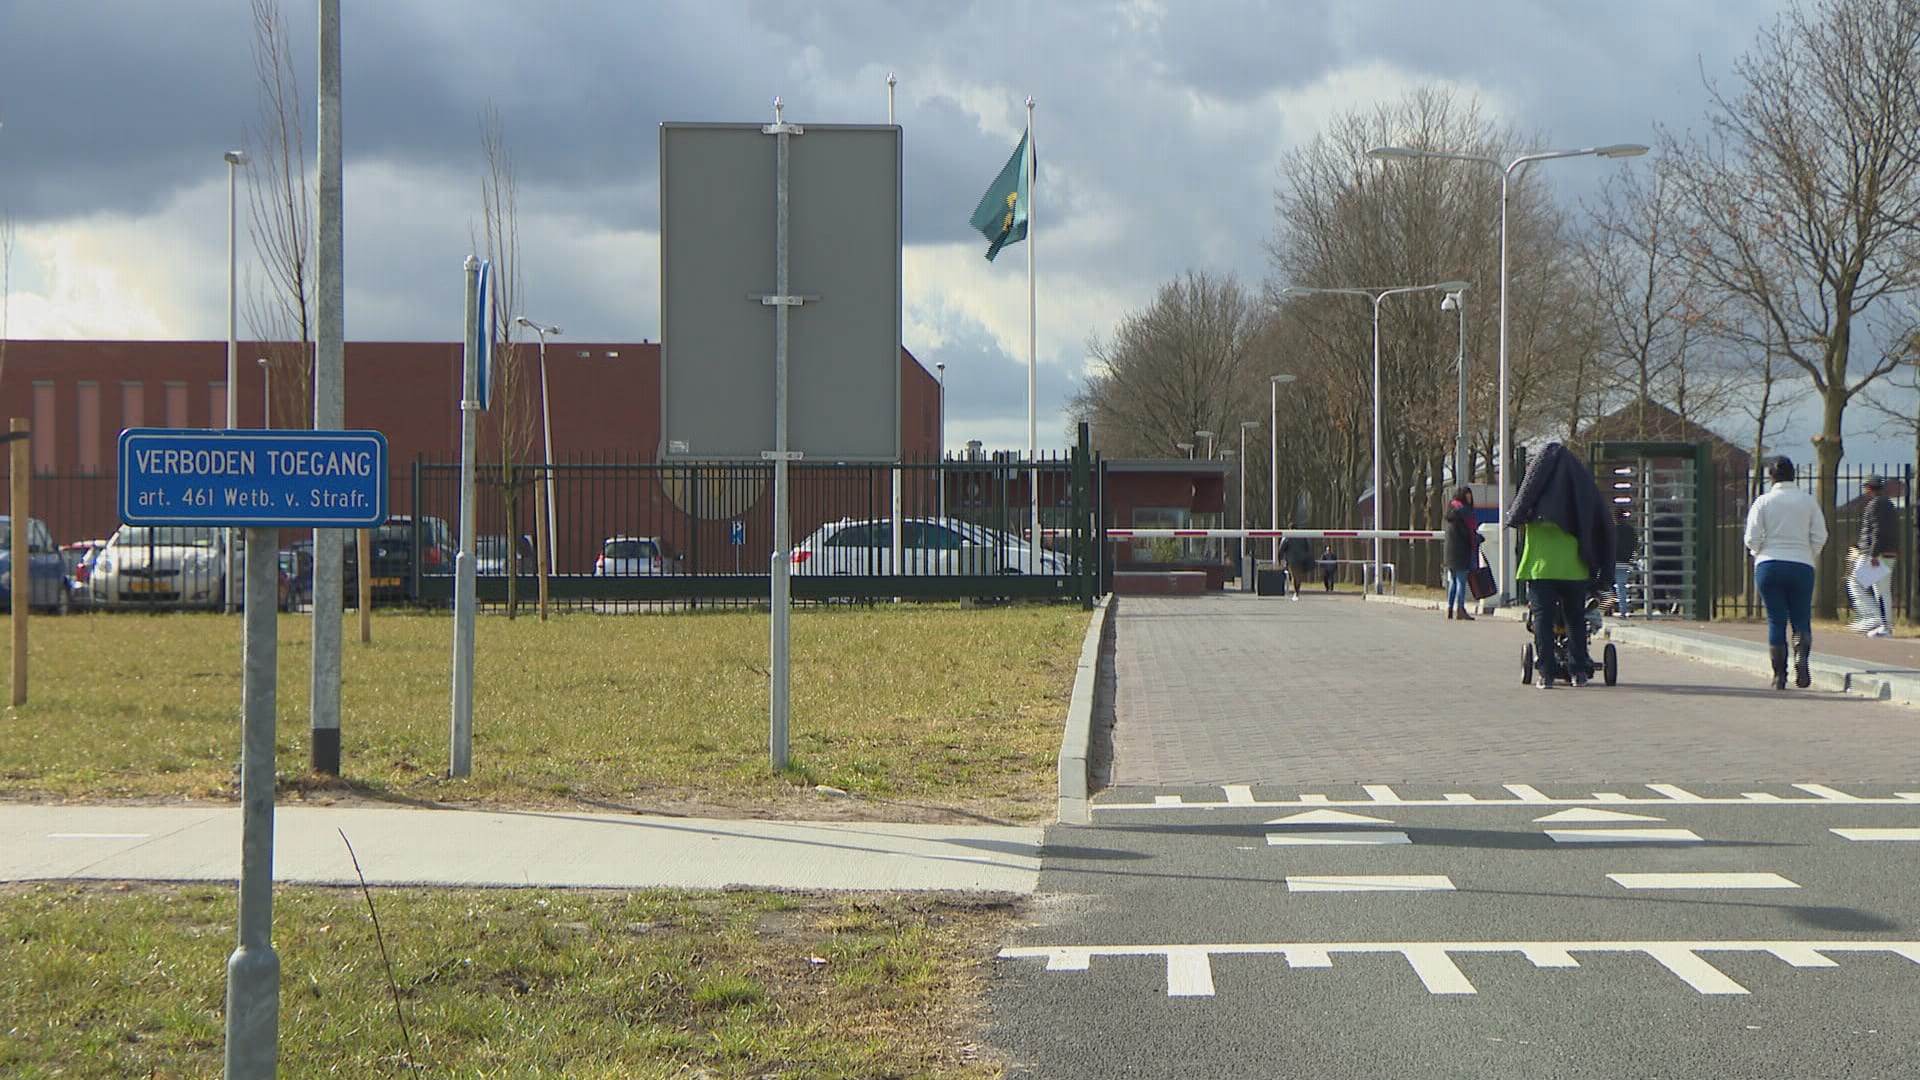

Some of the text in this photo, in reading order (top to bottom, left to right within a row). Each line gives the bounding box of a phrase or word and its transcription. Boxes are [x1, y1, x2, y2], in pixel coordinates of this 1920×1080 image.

[136, 449, 371, 476] VERBODEN TOEGANG
[139, 488, 370, 507] art. 461 Wetb. v. Strafr.
